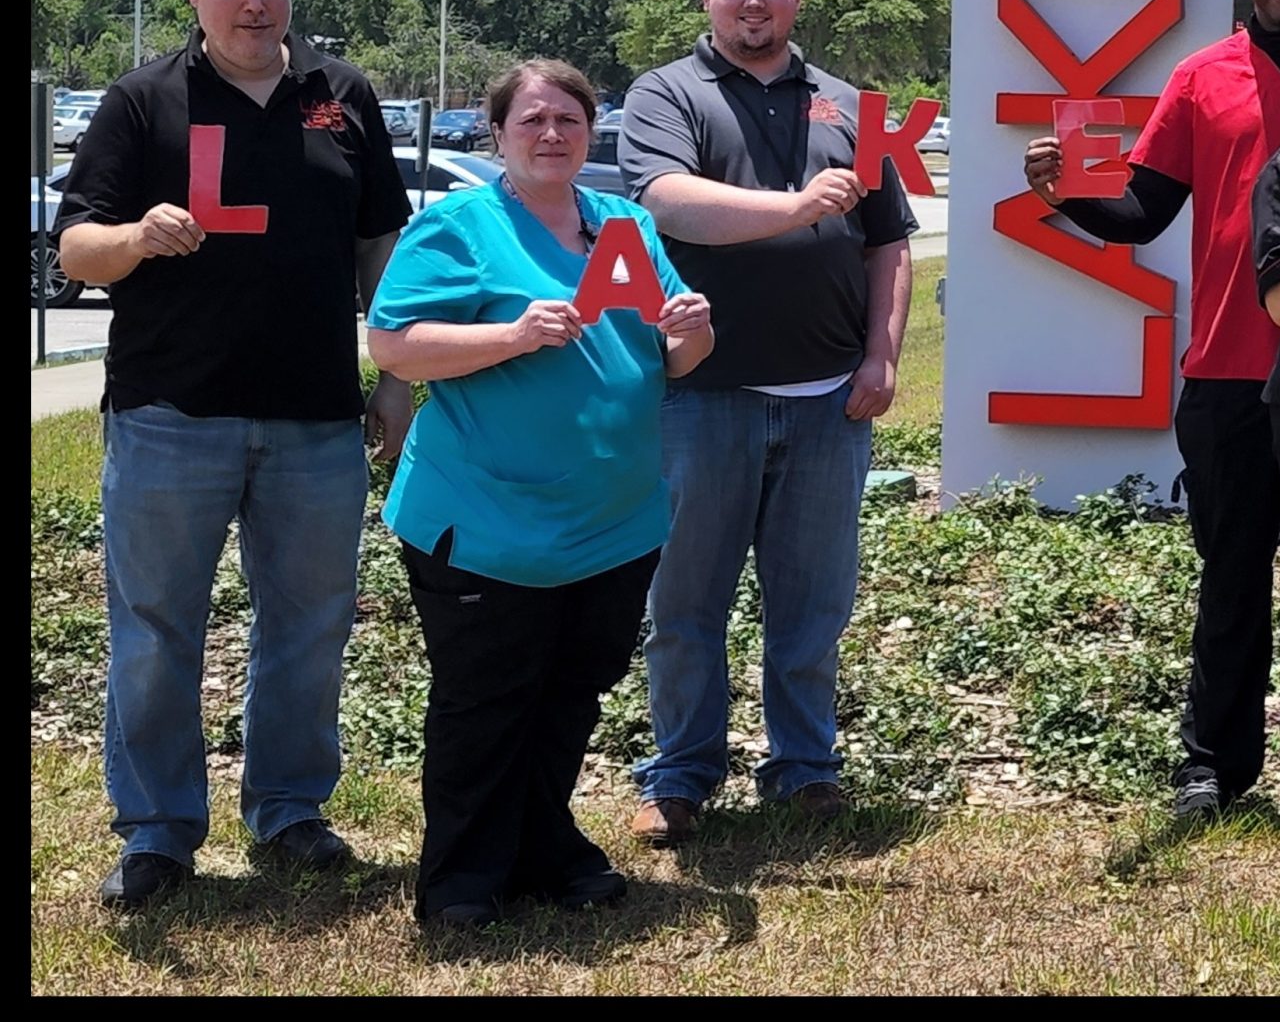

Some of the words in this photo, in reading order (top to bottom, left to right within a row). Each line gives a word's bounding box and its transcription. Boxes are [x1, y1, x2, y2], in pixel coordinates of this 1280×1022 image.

[188, 125, 269, 234] L
[854, 90, 943, 198] K
[1053, 99, 1133, 199] E
[572, 217, 667, 326] A
